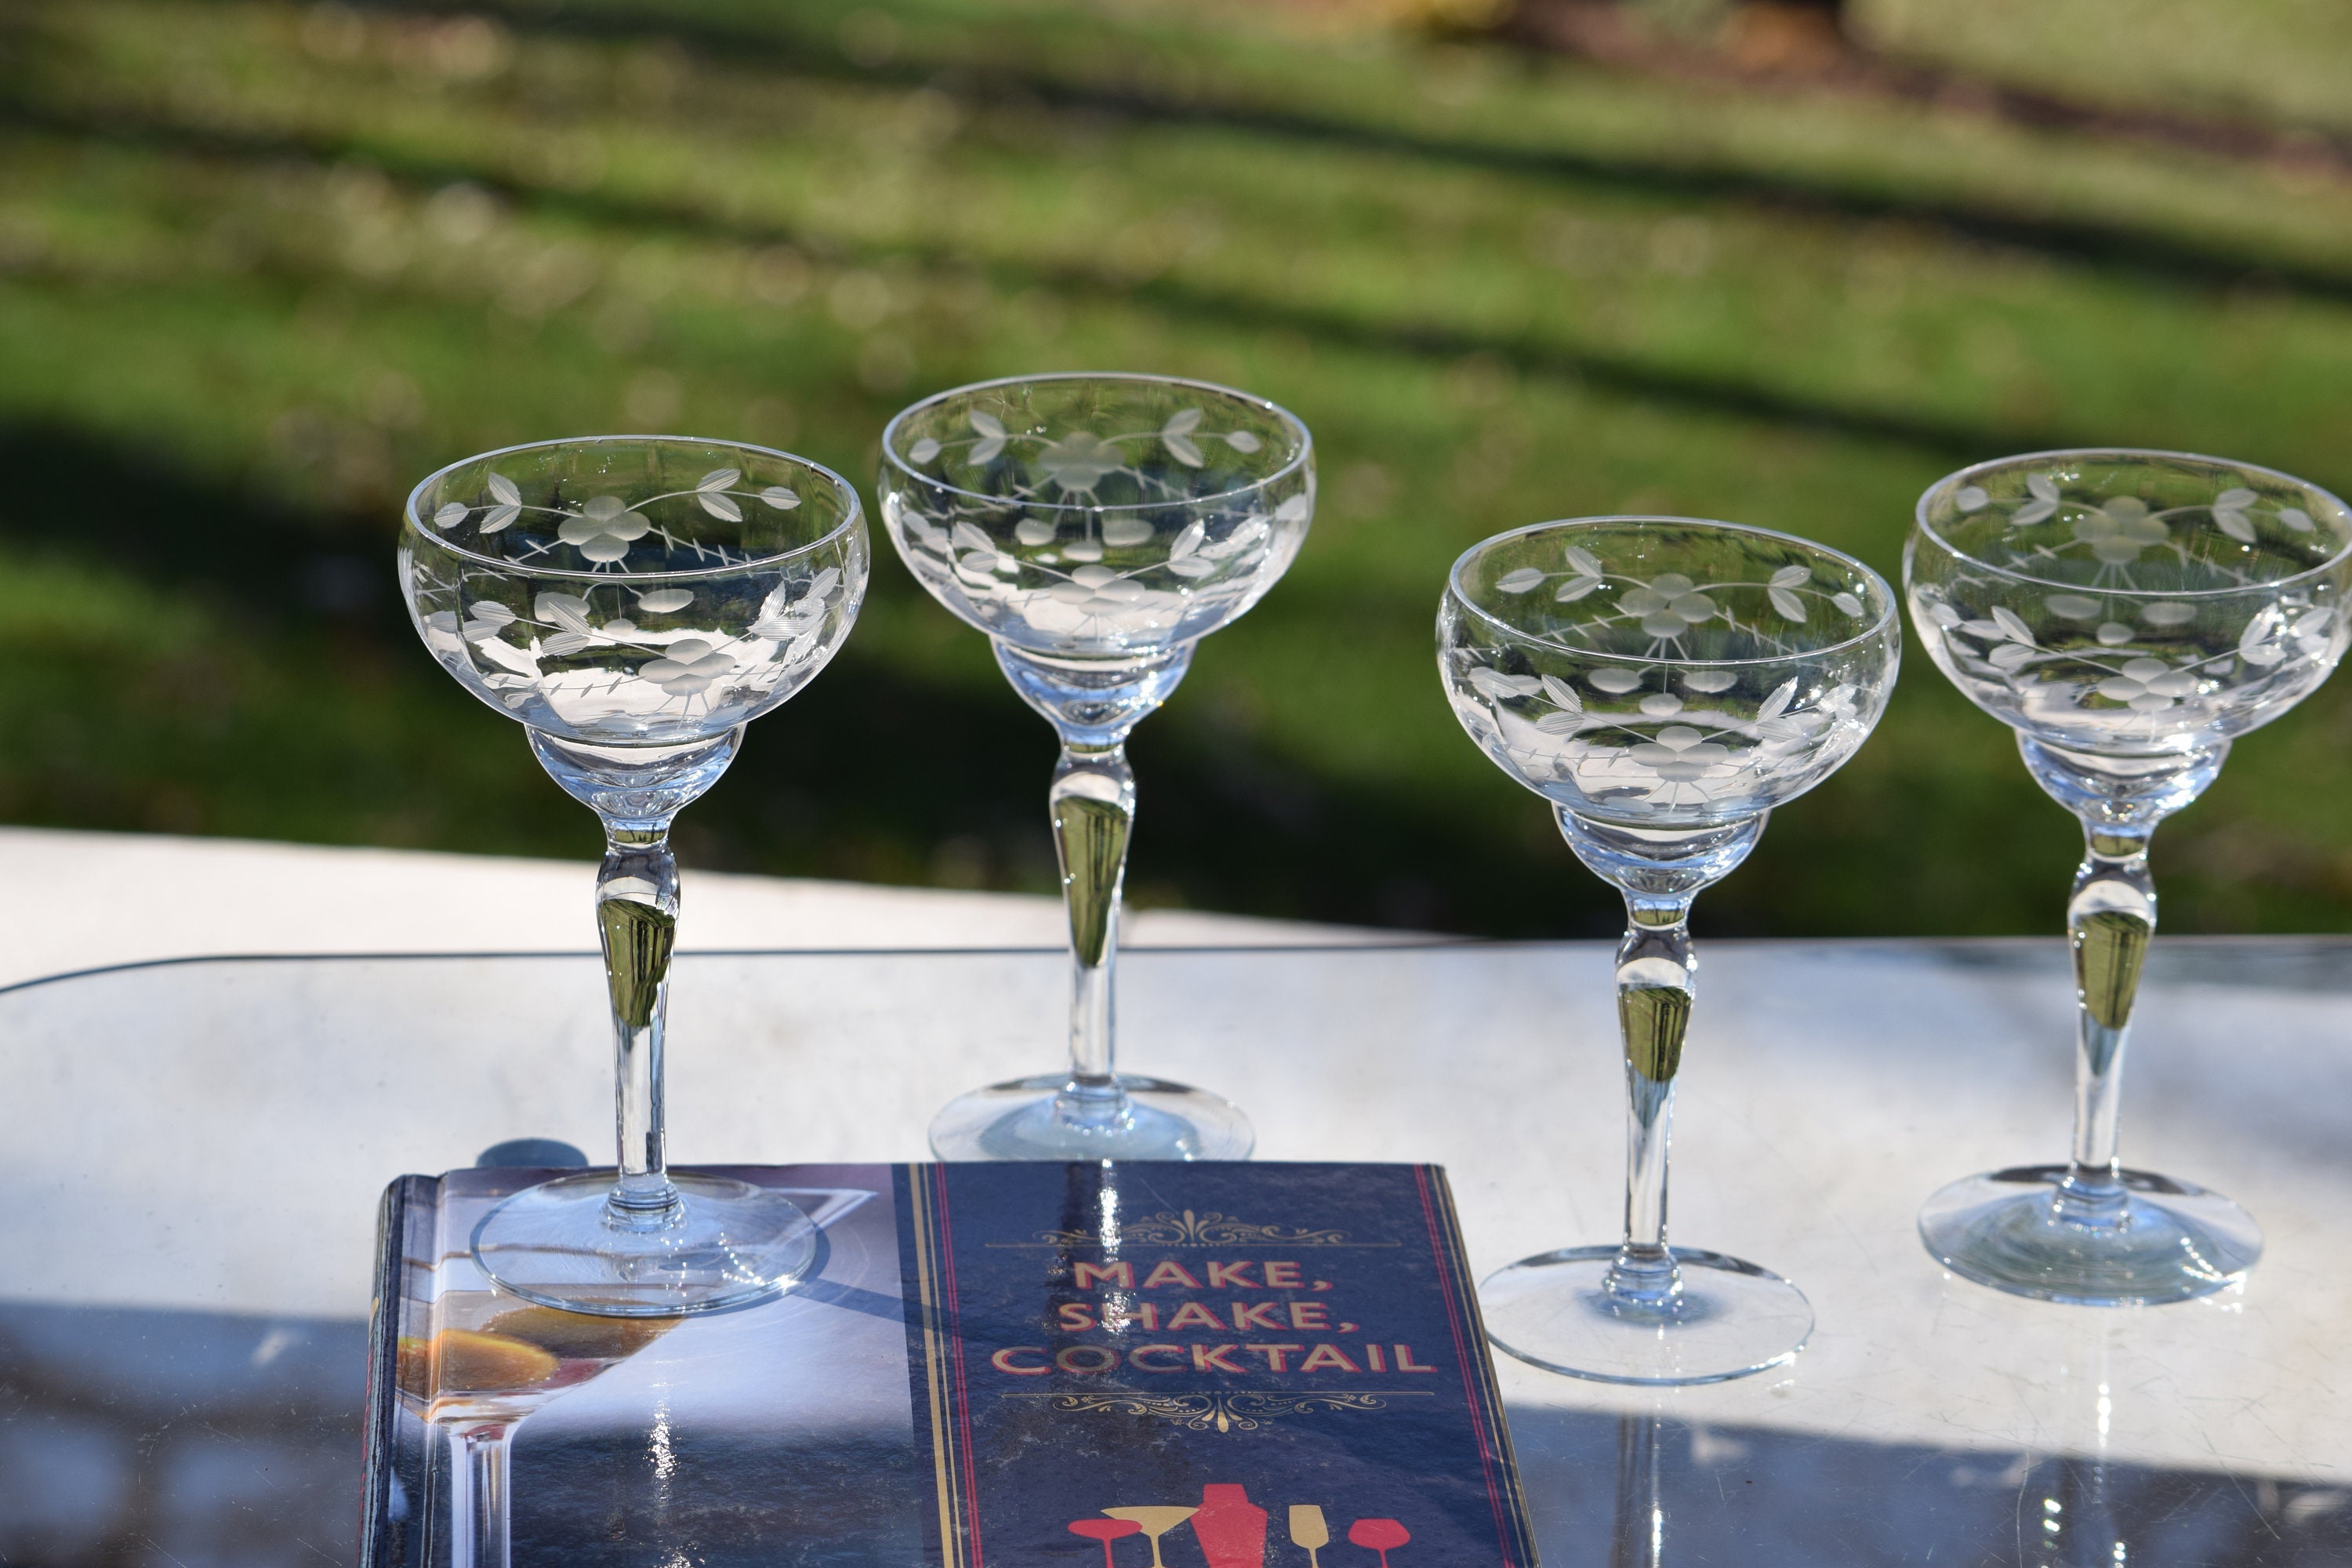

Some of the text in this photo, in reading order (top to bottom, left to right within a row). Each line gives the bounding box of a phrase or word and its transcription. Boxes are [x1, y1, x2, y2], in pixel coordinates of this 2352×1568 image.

[1074, 1261, 1333, 1291] MAKE,
[1058, 1301, 1359, 1333] SHAKE,
[991, 1343, 1438, 1375] COCKTAIL
